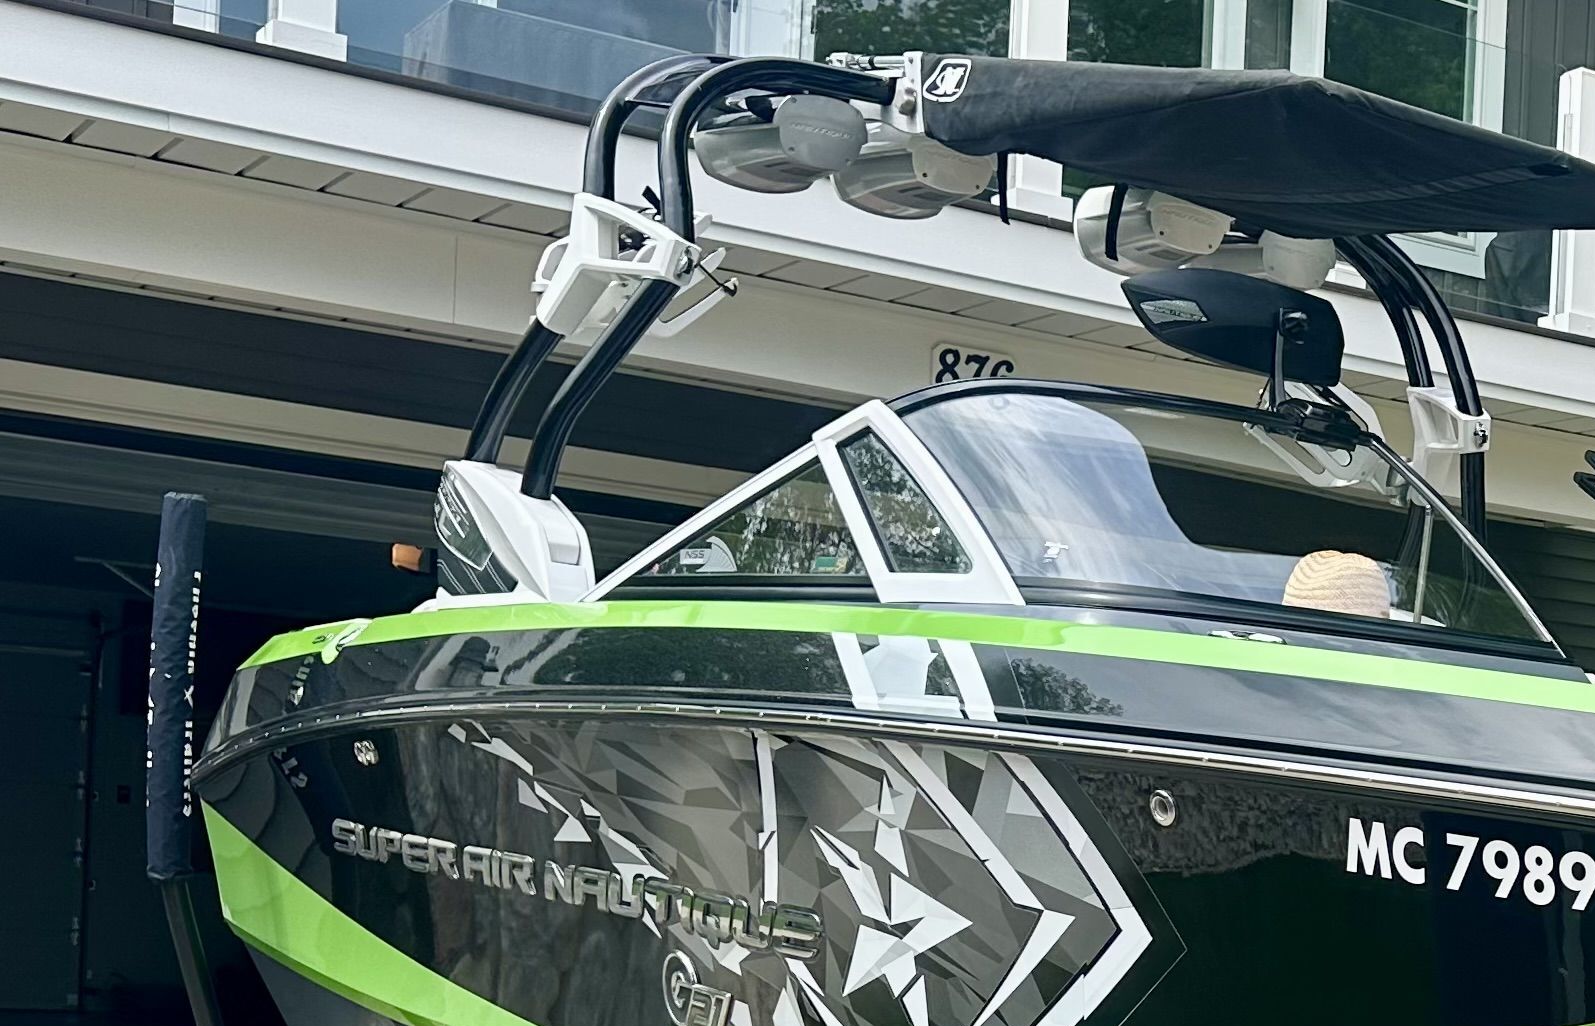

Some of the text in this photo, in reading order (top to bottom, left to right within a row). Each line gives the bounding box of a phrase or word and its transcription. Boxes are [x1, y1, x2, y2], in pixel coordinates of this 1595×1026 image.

[331, 817, 825, 962] SUPER AIR NAUTIQUE
[1346, 817, 1426, 885] MC
